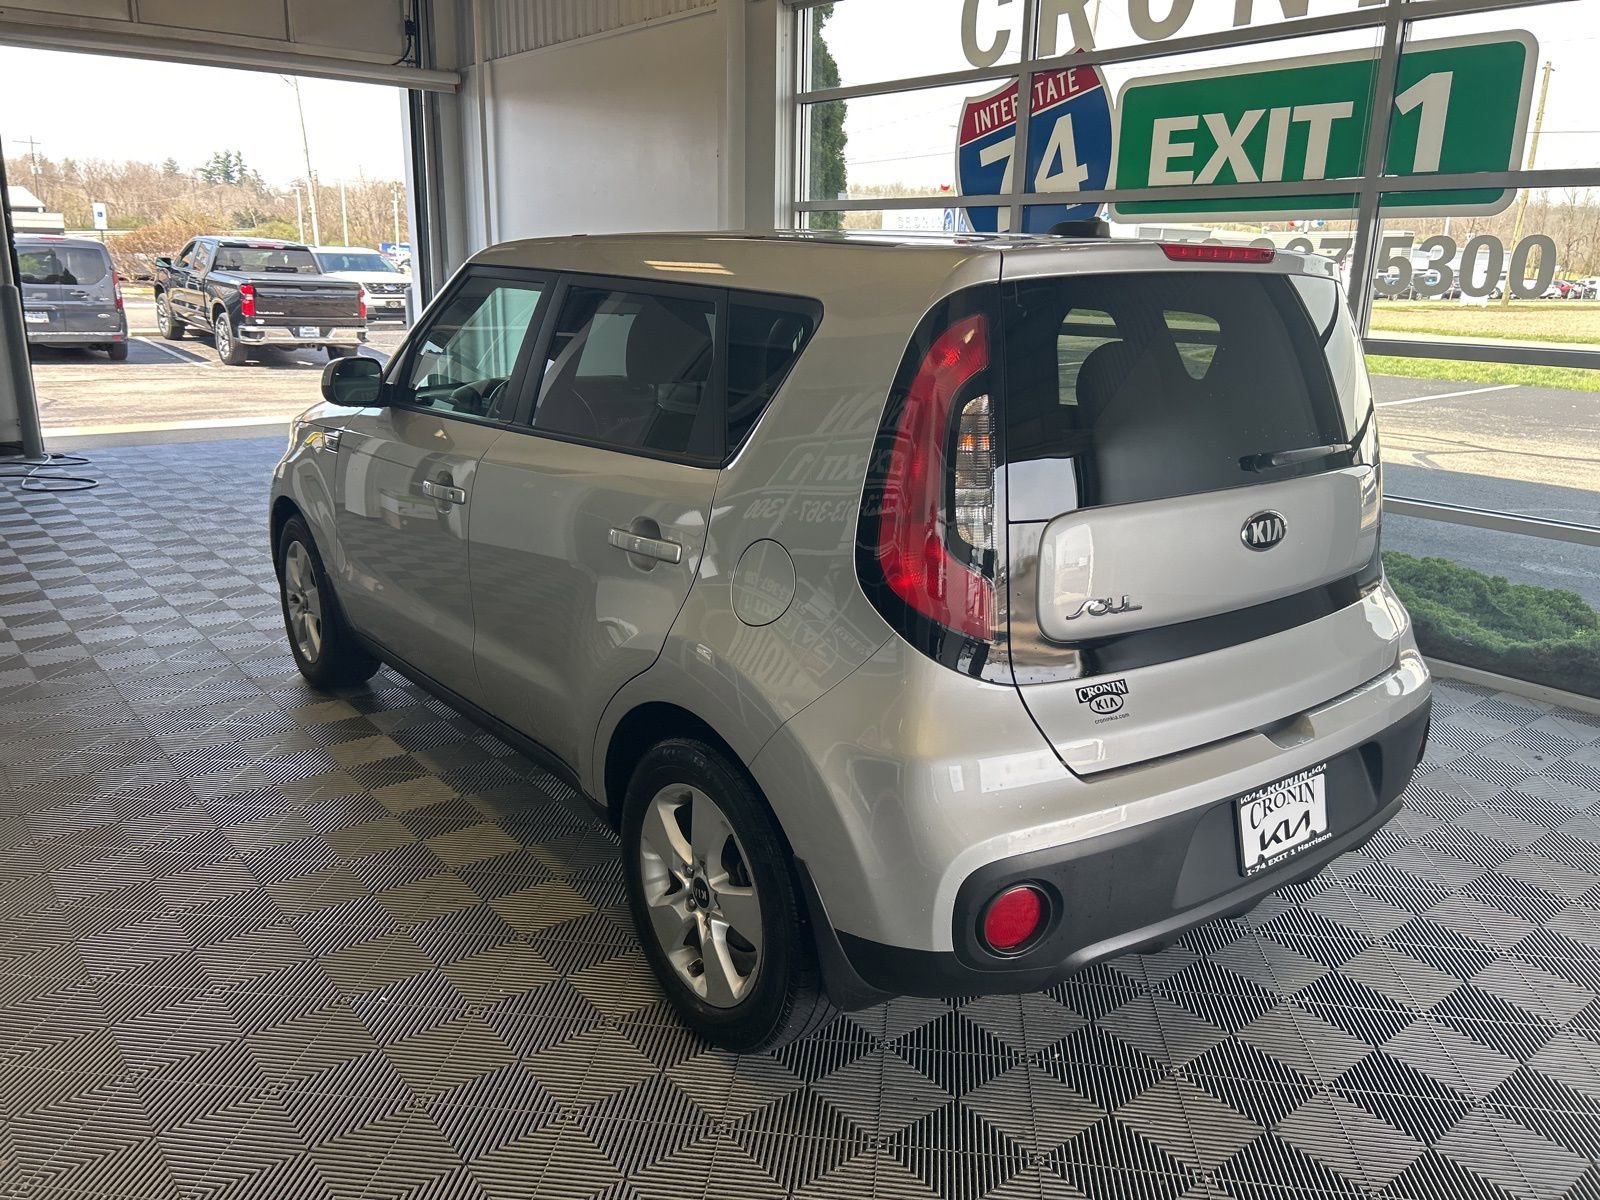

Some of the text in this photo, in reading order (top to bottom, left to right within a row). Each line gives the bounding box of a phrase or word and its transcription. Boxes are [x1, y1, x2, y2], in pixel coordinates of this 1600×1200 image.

[974, 68, 1080, 134] INTERTATE
[1148, 71, 1454, 187] EXIT 1
[980, 112, 1089, 231] 74
[1251, 518, 1284, 544] KIA
[1066, 594, 1143, 620] SOUL
[1078, 680, 1127, 702] CRONIN
[1095, 697, 1119, 711] KIA
[1094, 713, 1130, 725] croninkia.com
[1250, 779, 1316, 830] CRONIN
[1259, 809, 1311, 852] KIA
[1247, 863, 1266, 877] I-74
[1268, 851, 1289, 866] EXIT
[1298, 832, 1332, 852] Harrison
